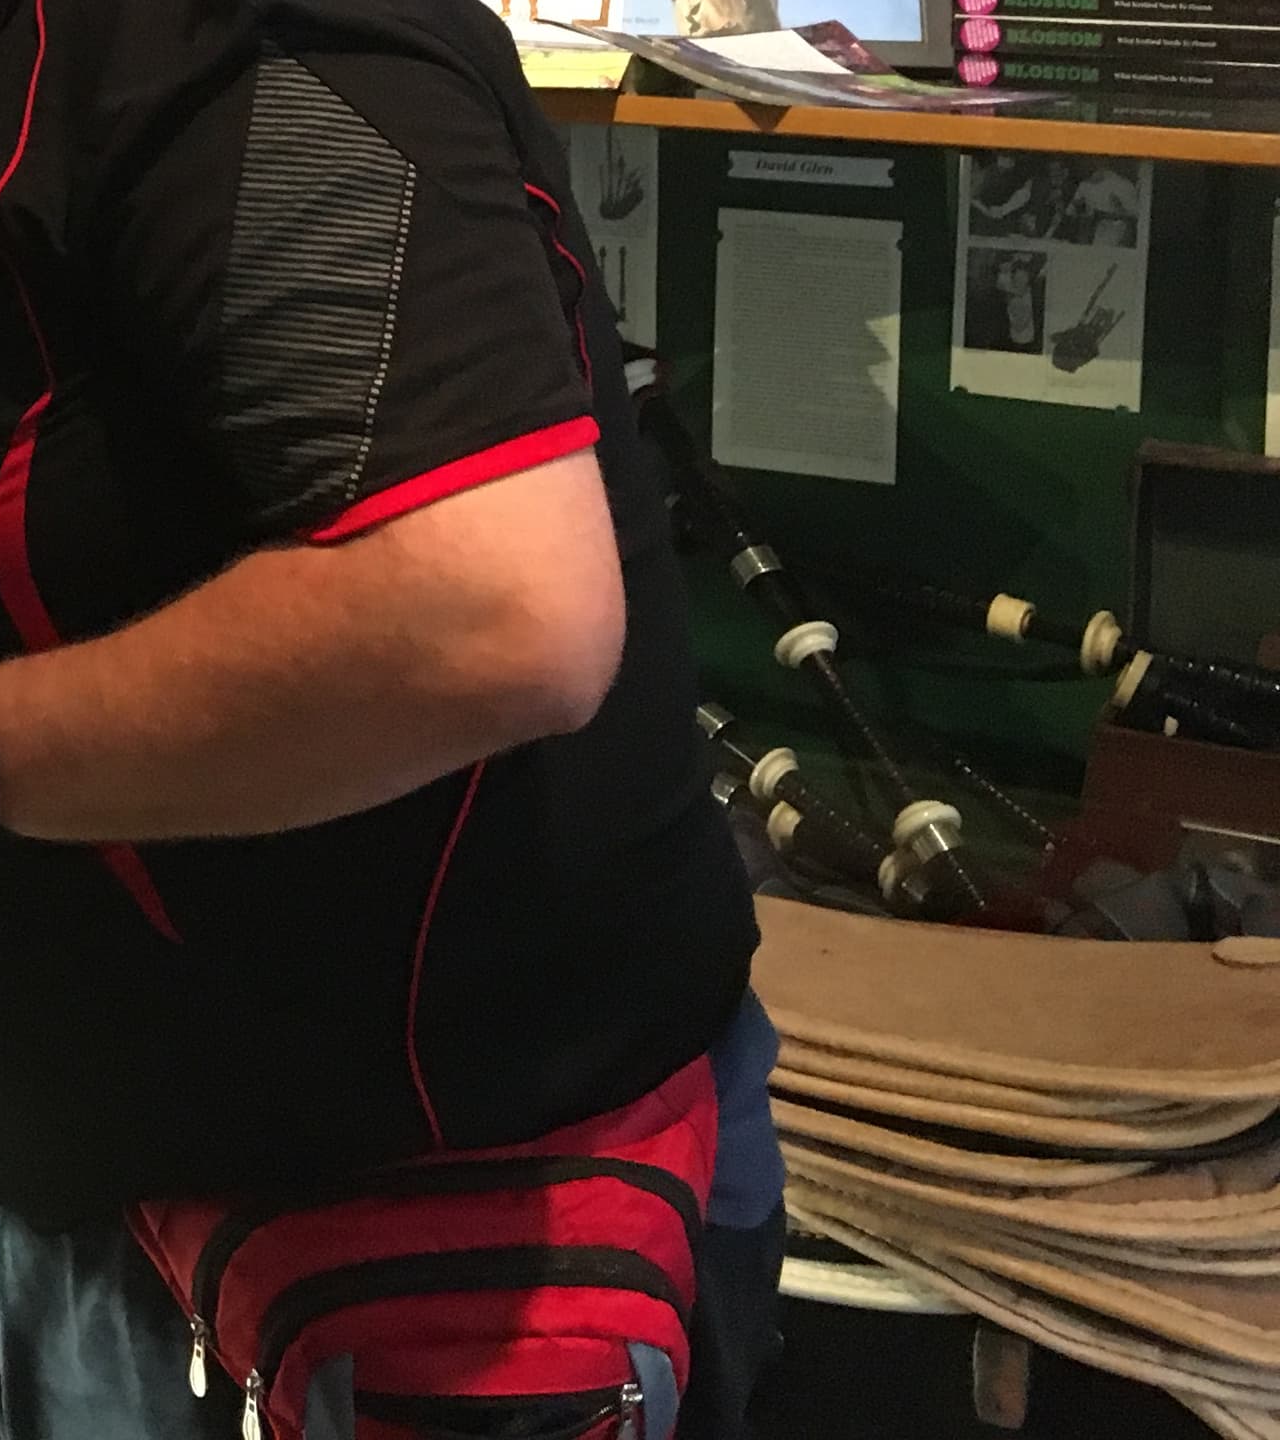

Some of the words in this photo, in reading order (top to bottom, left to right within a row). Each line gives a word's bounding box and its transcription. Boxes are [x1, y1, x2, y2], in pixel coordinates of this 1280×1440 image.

[1006, 28, 1102, 47] BLOSSOM
[1004, 64, 1100, 82] BLOSSOM
[755, 158, 797, 175] David
[799, 159, 834, 177] Glen
